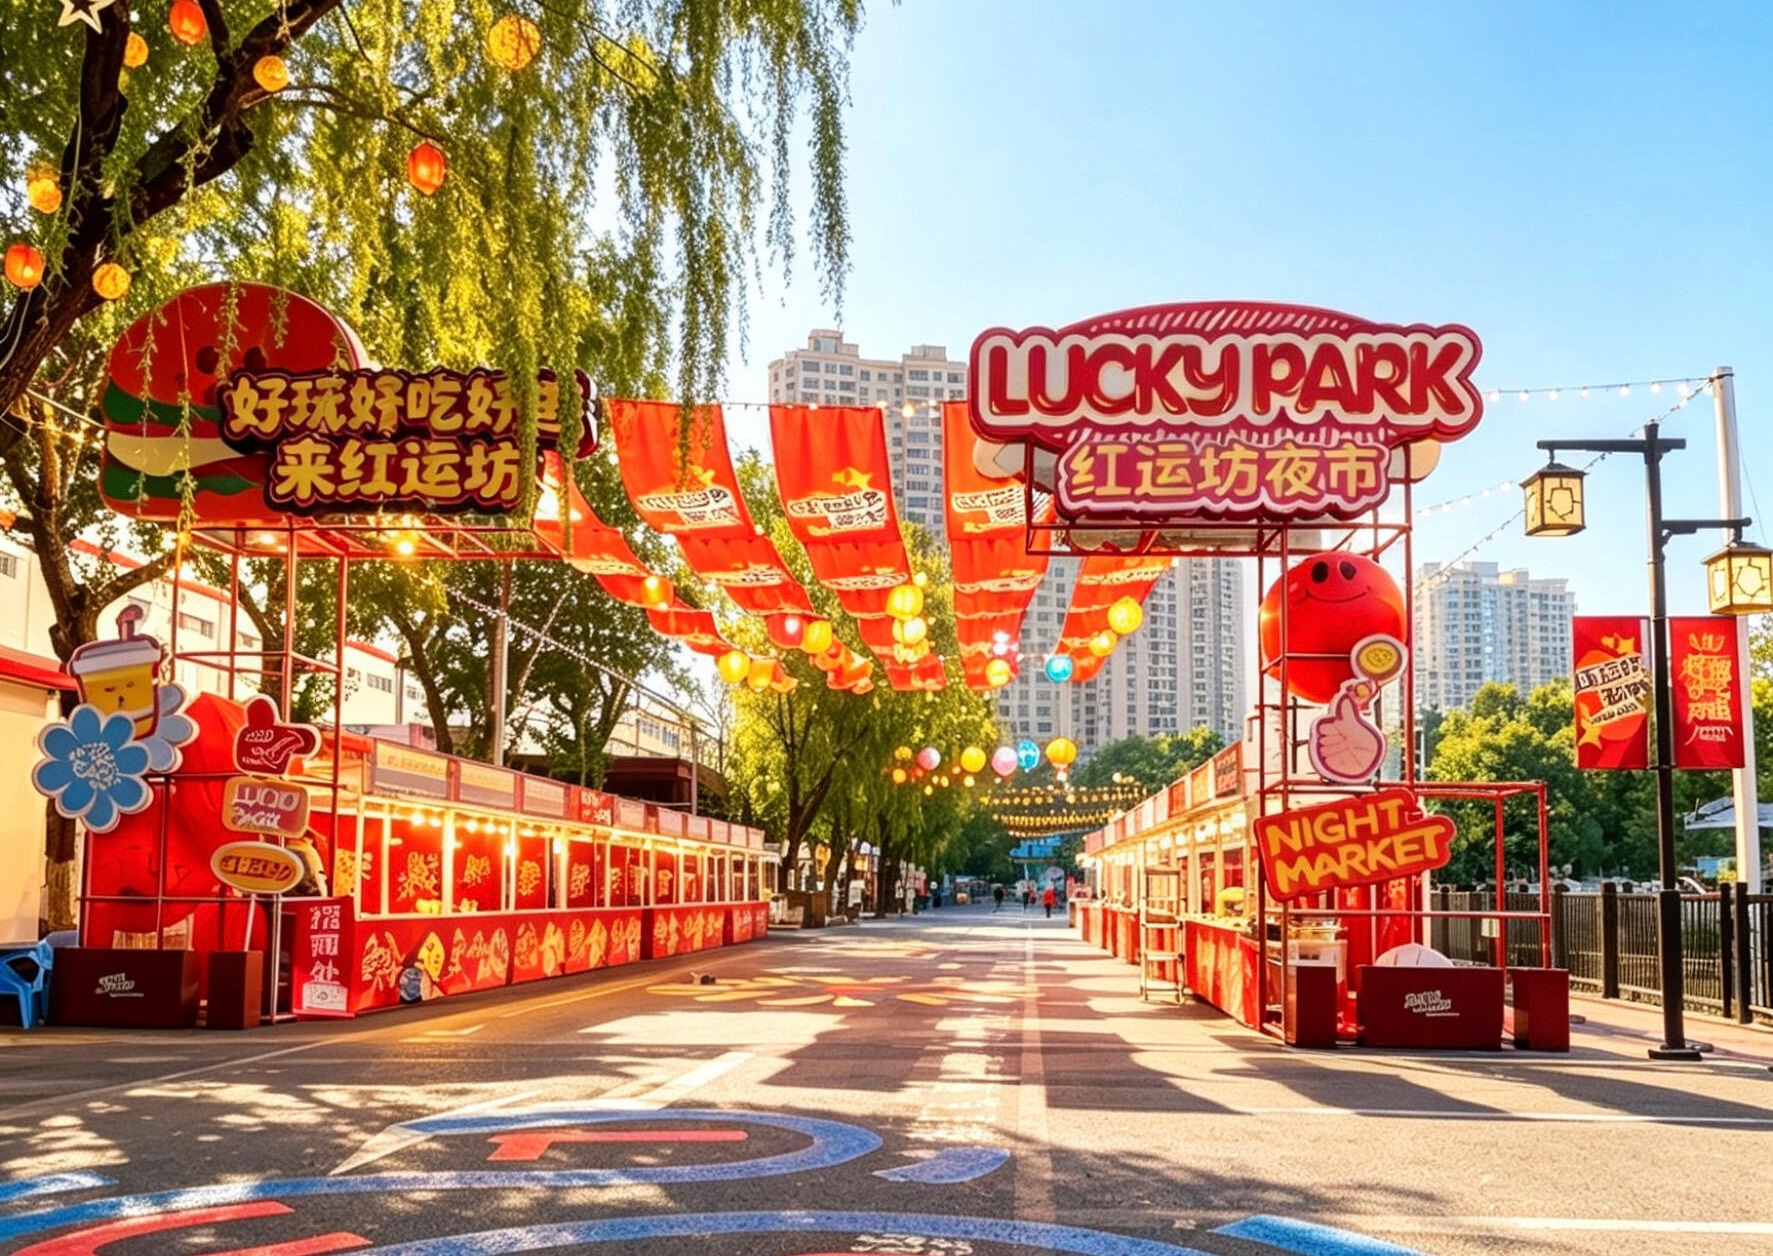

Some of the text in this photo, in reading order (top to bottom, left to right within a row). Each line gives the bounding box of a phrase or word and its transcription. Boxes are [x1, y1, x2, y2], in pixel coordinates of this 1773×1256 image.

[989, 341, 1466, 415] LUCKY PARK
[275, 436, 522, 500] 来红运坊
[1070, 445, 1378, 499] 红运坊夜市
[1265, 799, 1405, 857] NIGHT
[1274, 825, 1446, 894] MARKET
